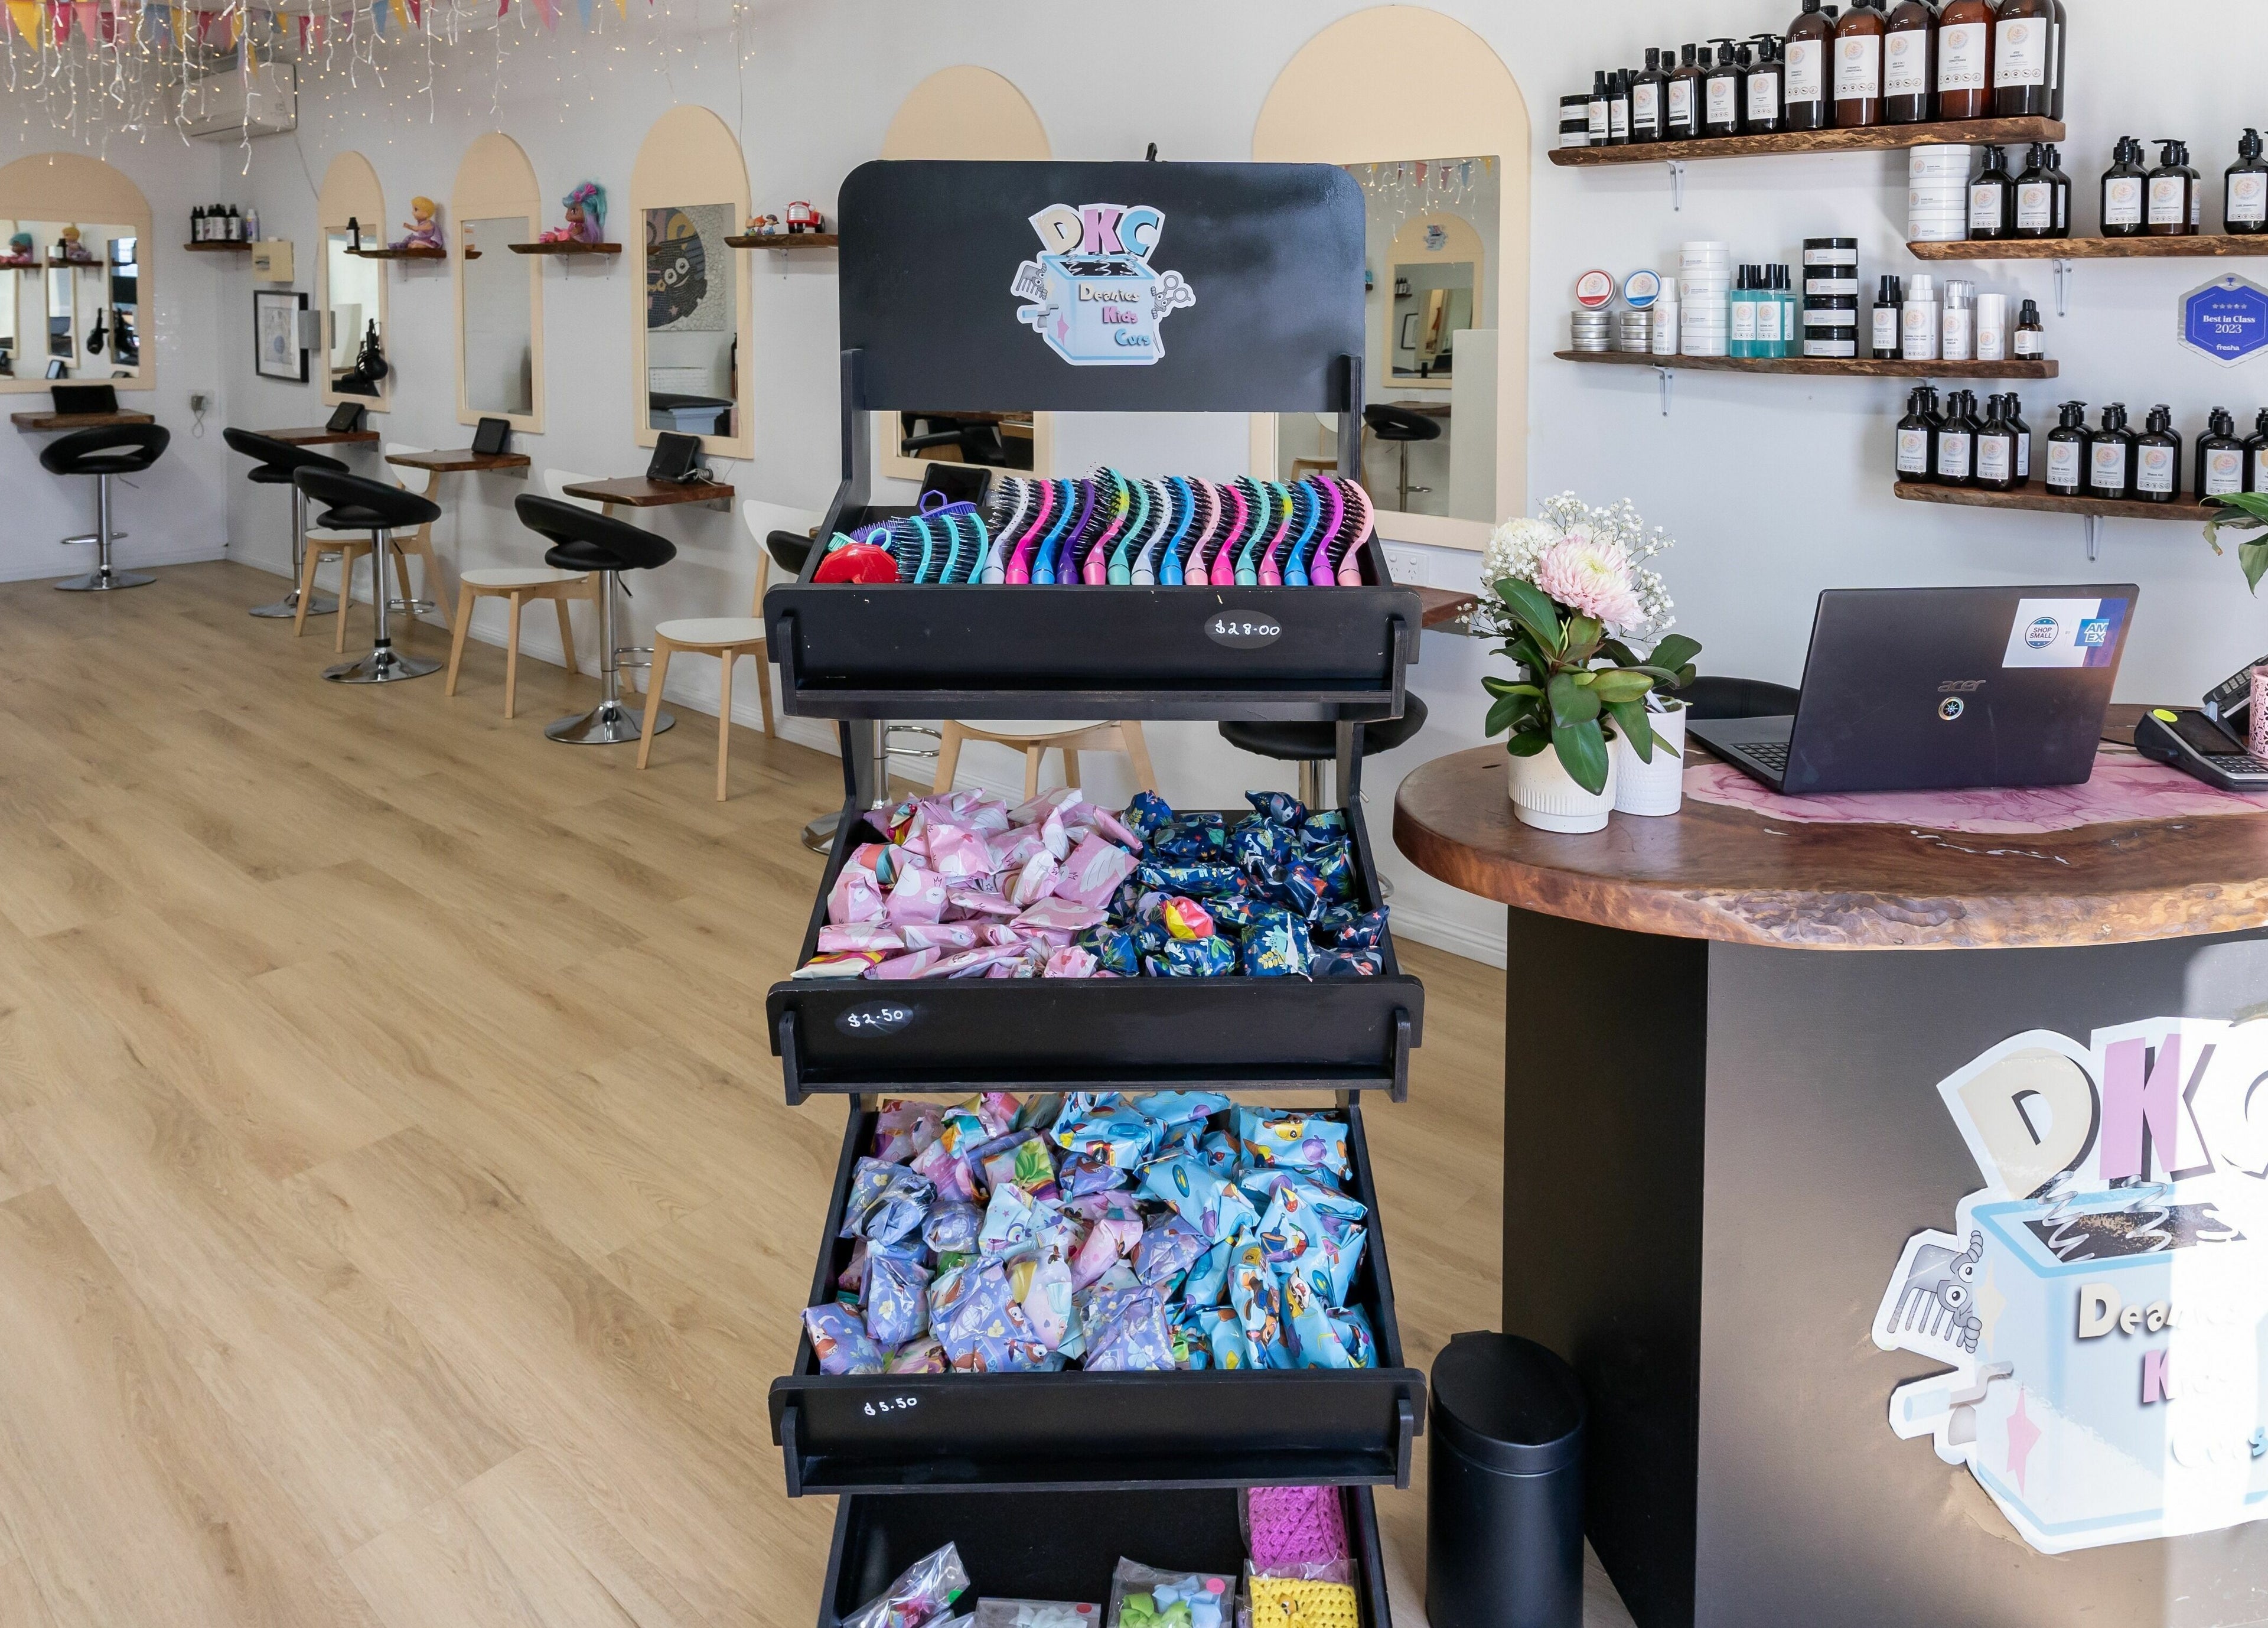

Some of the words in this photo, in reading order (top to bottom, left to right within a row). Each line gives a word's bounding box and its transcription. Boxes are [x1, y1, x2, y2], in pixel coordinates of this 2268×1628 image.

[1037, 209, 1159, 257] DKC
[1079, 282, 1140, 302] Deanies
[1103, 306, 1139, 324] Kids
[2215, 324, 2242, 334] 2023
[1215, 619, 1280, 635] $28.00
[2084, 623, 2109, 634] AM
[2084, 632, 2106, 643] EX
[1938, 680, 1986, 692] acer
[848, 1008, 903, 1027] $2.50
[864, 1398, 917, 1415] $5.50
